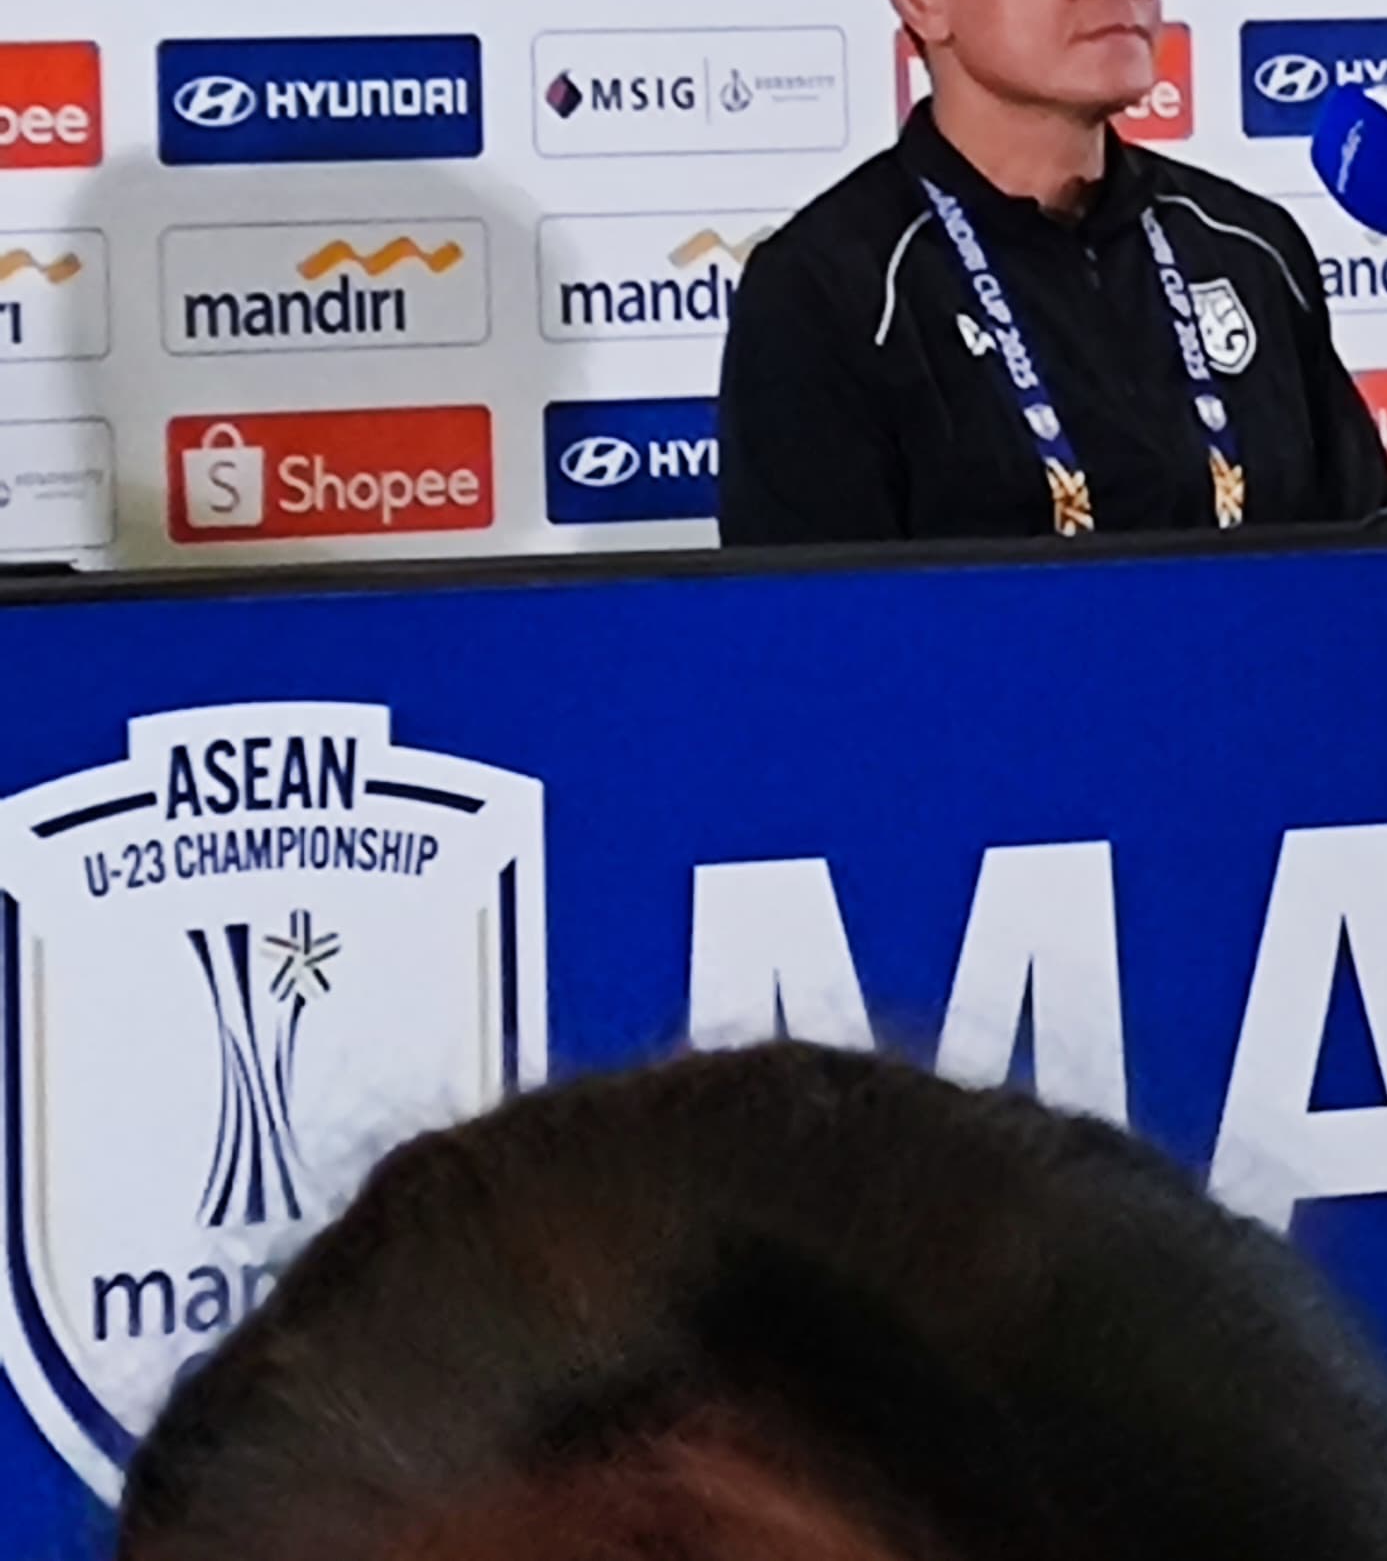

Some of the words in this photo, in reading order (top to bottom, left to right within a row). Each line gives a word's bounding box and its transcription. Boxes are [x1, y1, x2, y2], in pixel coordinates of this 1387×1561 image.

[266, 77, 468, 119] HYUNDAI
[591, 76, 695, 111] MSIG
[184, 273, 406, 339] mandiri
[279, 459, 479, 523] Shopee
[165, 735, 357, 821] ASEAN
[84, 839, 166, 898] U-23
[174, 825, 439, 879] CHAMPIONSHIP
